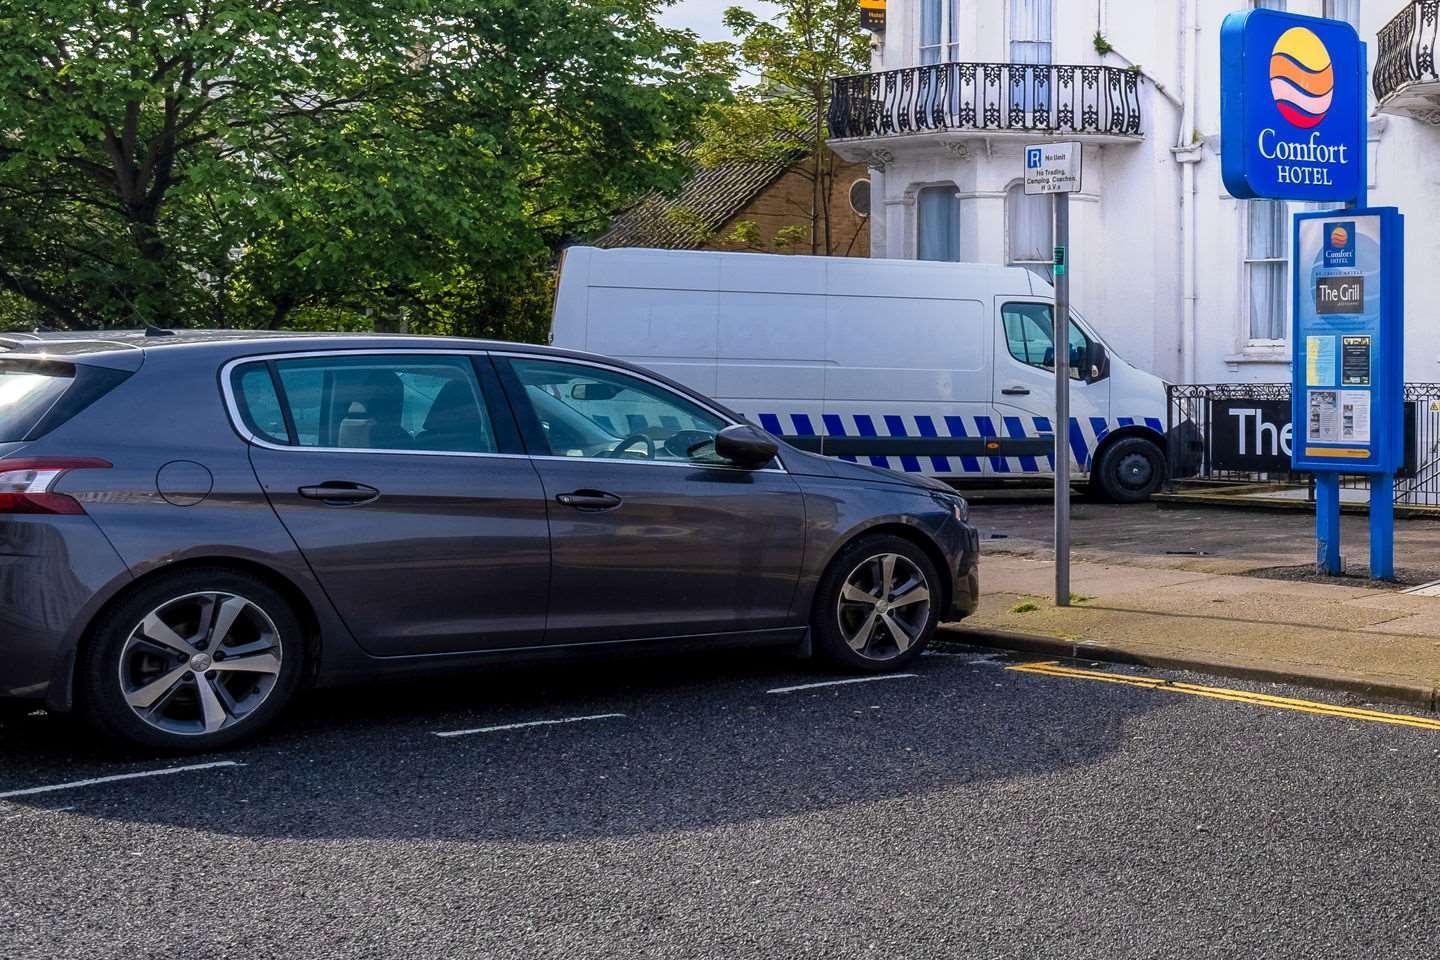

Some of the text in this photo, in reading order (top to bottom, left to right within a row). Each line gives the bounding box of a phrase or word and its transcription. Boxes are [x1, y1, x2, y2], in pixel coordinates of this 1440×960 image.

[1258, 128, 1349, 164] Comfort
[1277, 165, 1333, 186] HOTEL
[1325, 249, 1353, 258] Comfort
[1320, 284, 1359, 301] The Grill
[1229, 408, 1292, 456] The
